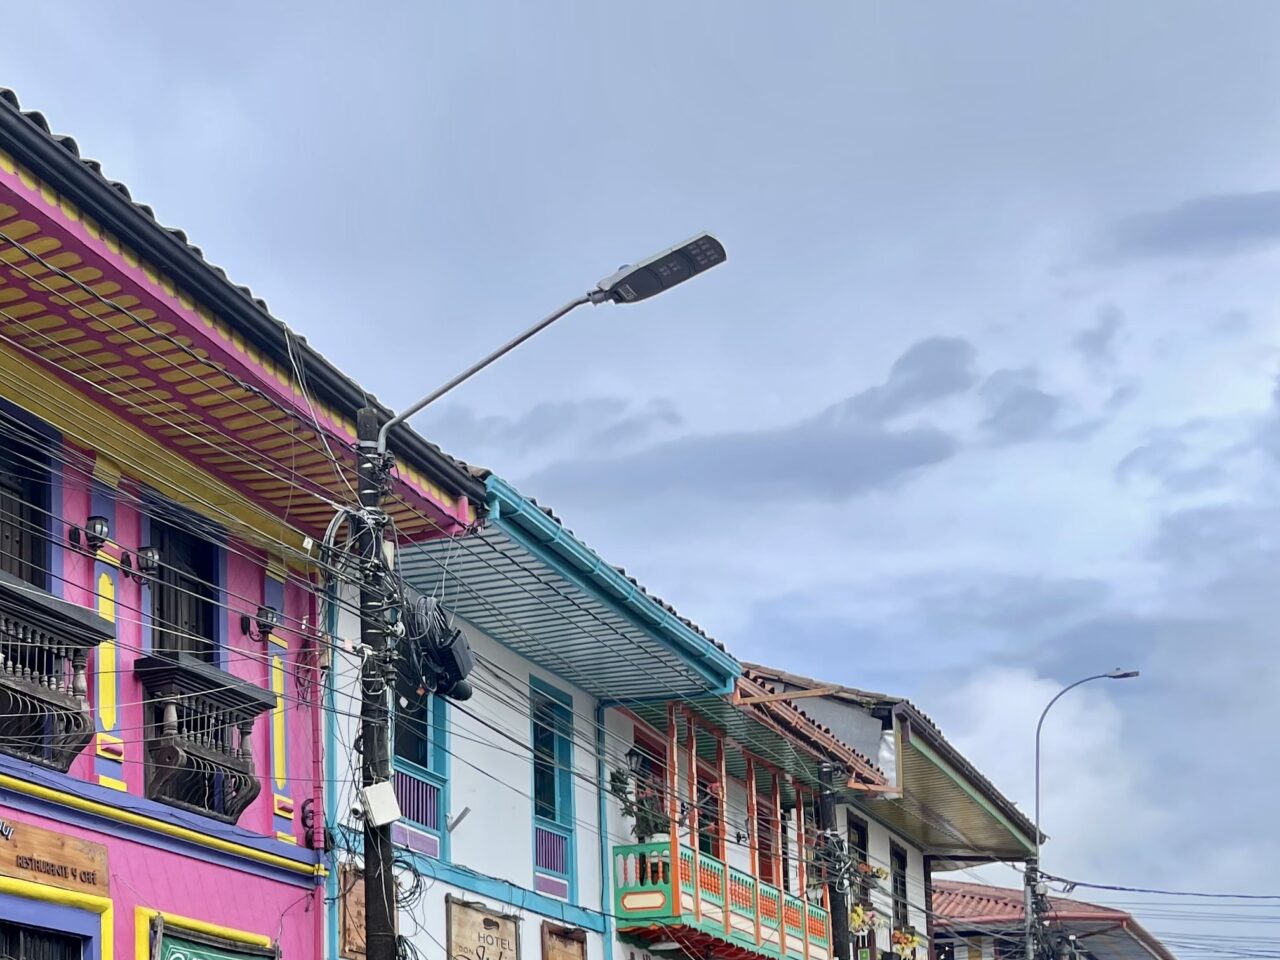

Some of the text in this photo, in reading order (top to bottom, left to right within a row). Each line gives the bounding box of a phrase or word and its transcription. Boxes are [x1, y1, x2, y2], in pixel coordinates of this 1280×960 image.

[16, 855, 69, 879] RESTAURANTE
[70, 867, 77, 880] Y
[458, 945, 474, 955] DON
[478, 931, 513, 951] HOTEL
